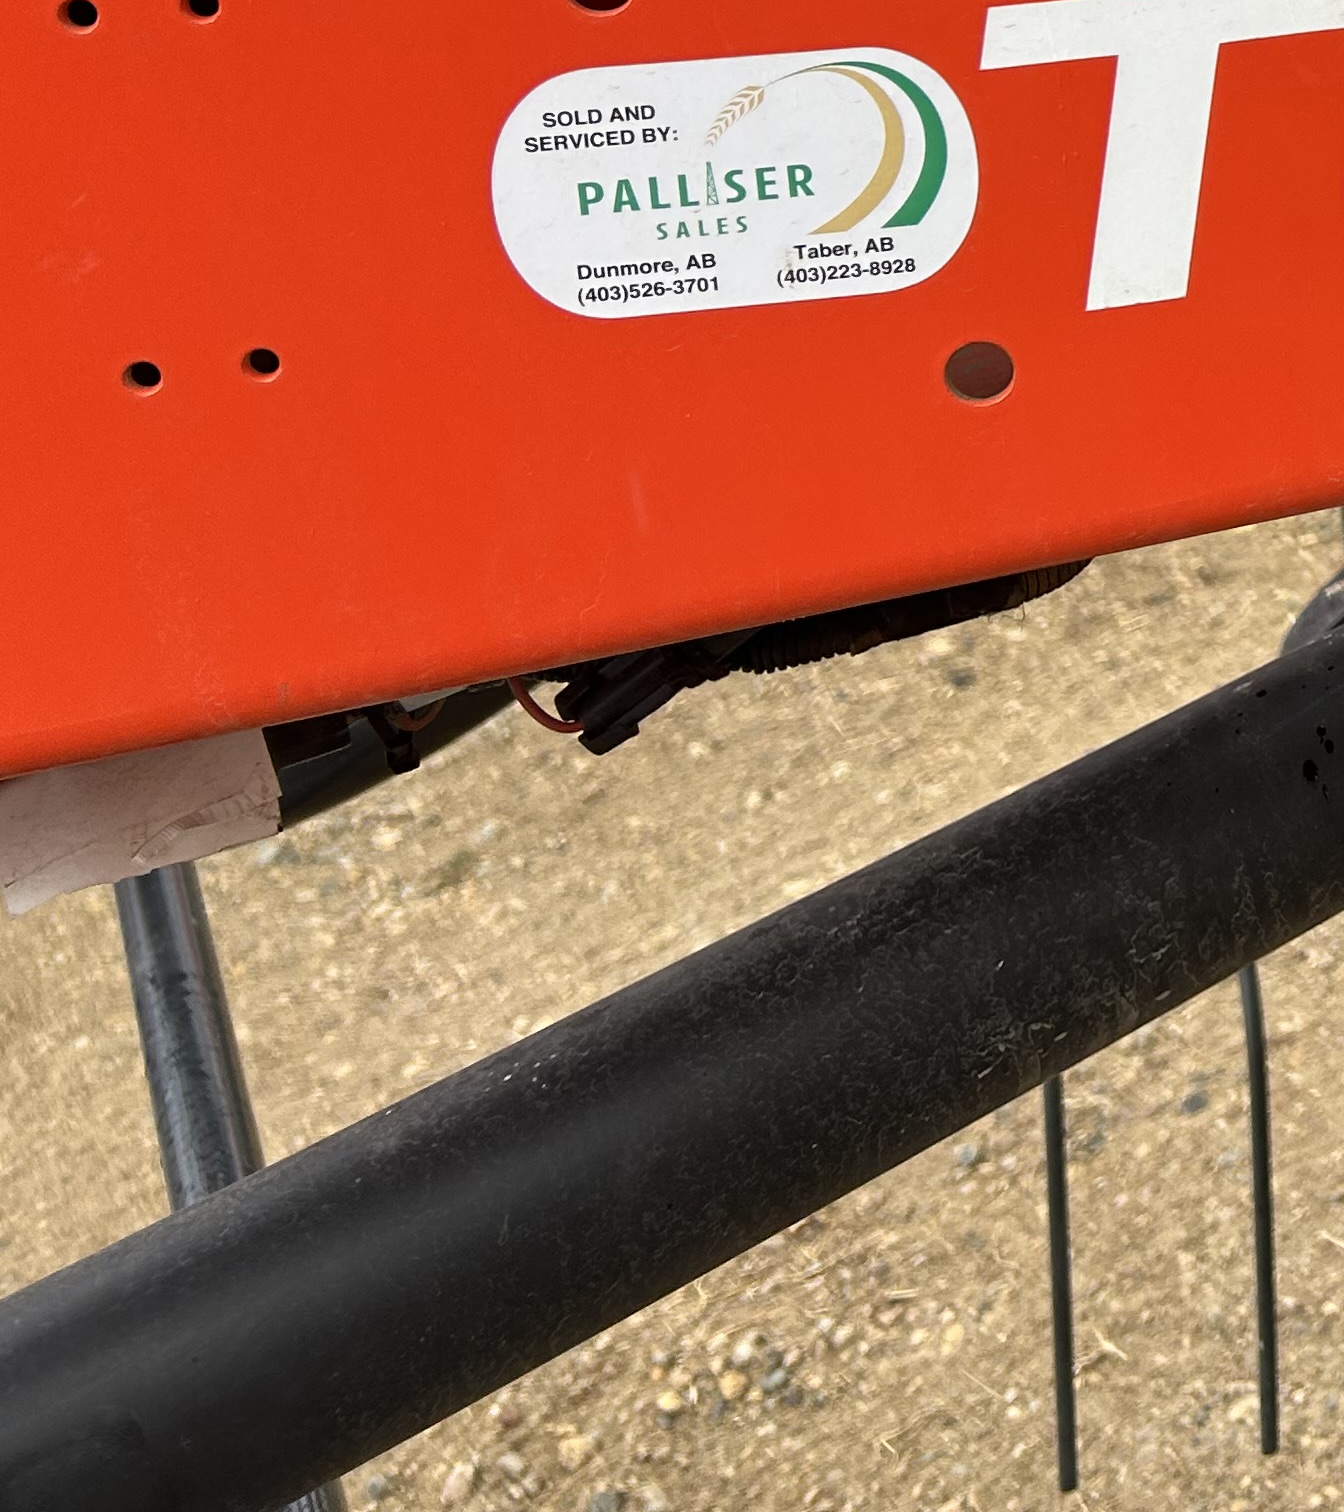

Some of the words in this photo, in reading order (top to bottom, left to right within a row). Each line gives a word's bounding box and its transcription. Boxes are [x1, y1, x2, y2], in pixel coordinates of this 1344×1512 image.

[541, 107, 603, 129] SOLD
[609, 104, 656, 124] AND
[524, 129, 636, 154] SERVICED
[641, 126, 680, 144] BY:
[577, 161, 816, 216] PALLISER
[656, 215, 749, 241] SALES
[792, 240, 859, 261] Taber,
[864, 236, 896, 255] AB
[576, 257, 680, 281] Dunmore,
[686, 253, 718, 272] AB
[776, 257, 917, 289] (403)223-8928
[576, 276, 720, 308] (403)526-3701
